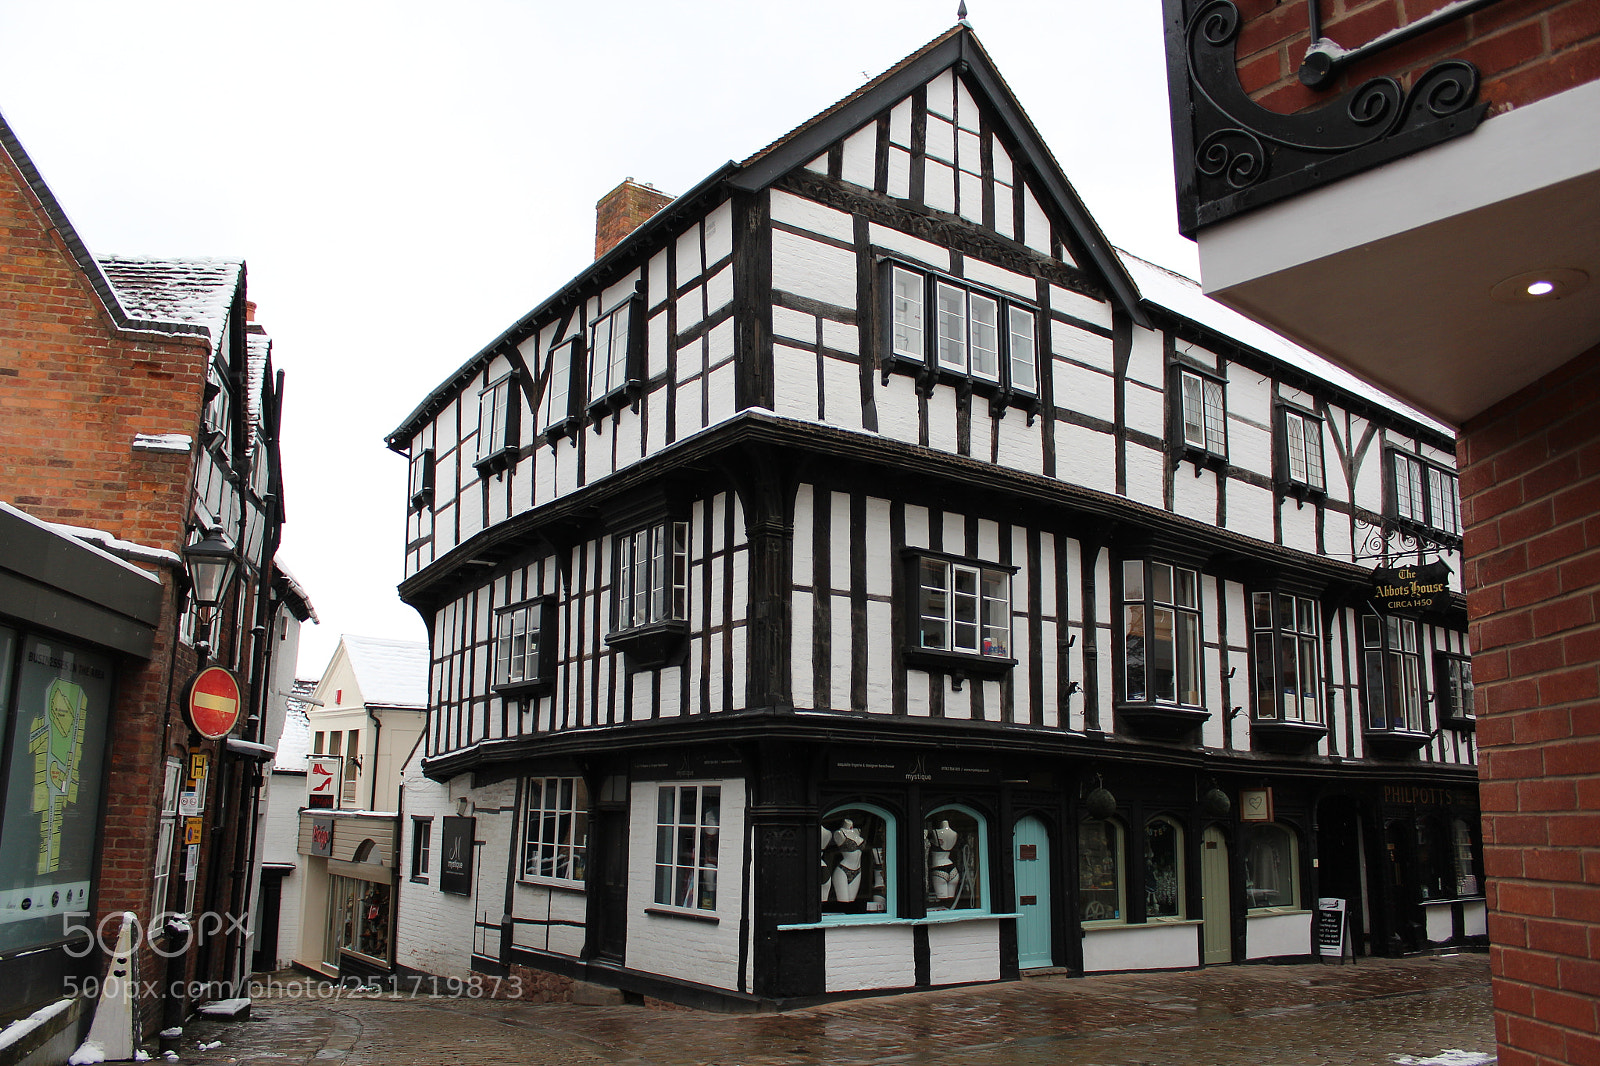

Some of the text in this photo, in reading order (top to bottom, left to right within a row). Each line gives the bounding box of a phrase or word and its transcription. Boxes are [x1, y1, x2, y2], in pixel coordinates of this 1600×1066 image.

[1398, 569, 1416, 580] The
[1410, 581, 1444, 598] House
[1388, 599, 1432, 609] CIRCA 1450
[28, 652, 68, 671] BUSINESSES
[905, 773, 932, 782] mystique
[1384, 785, 1453, 805] PHILPOTTS
